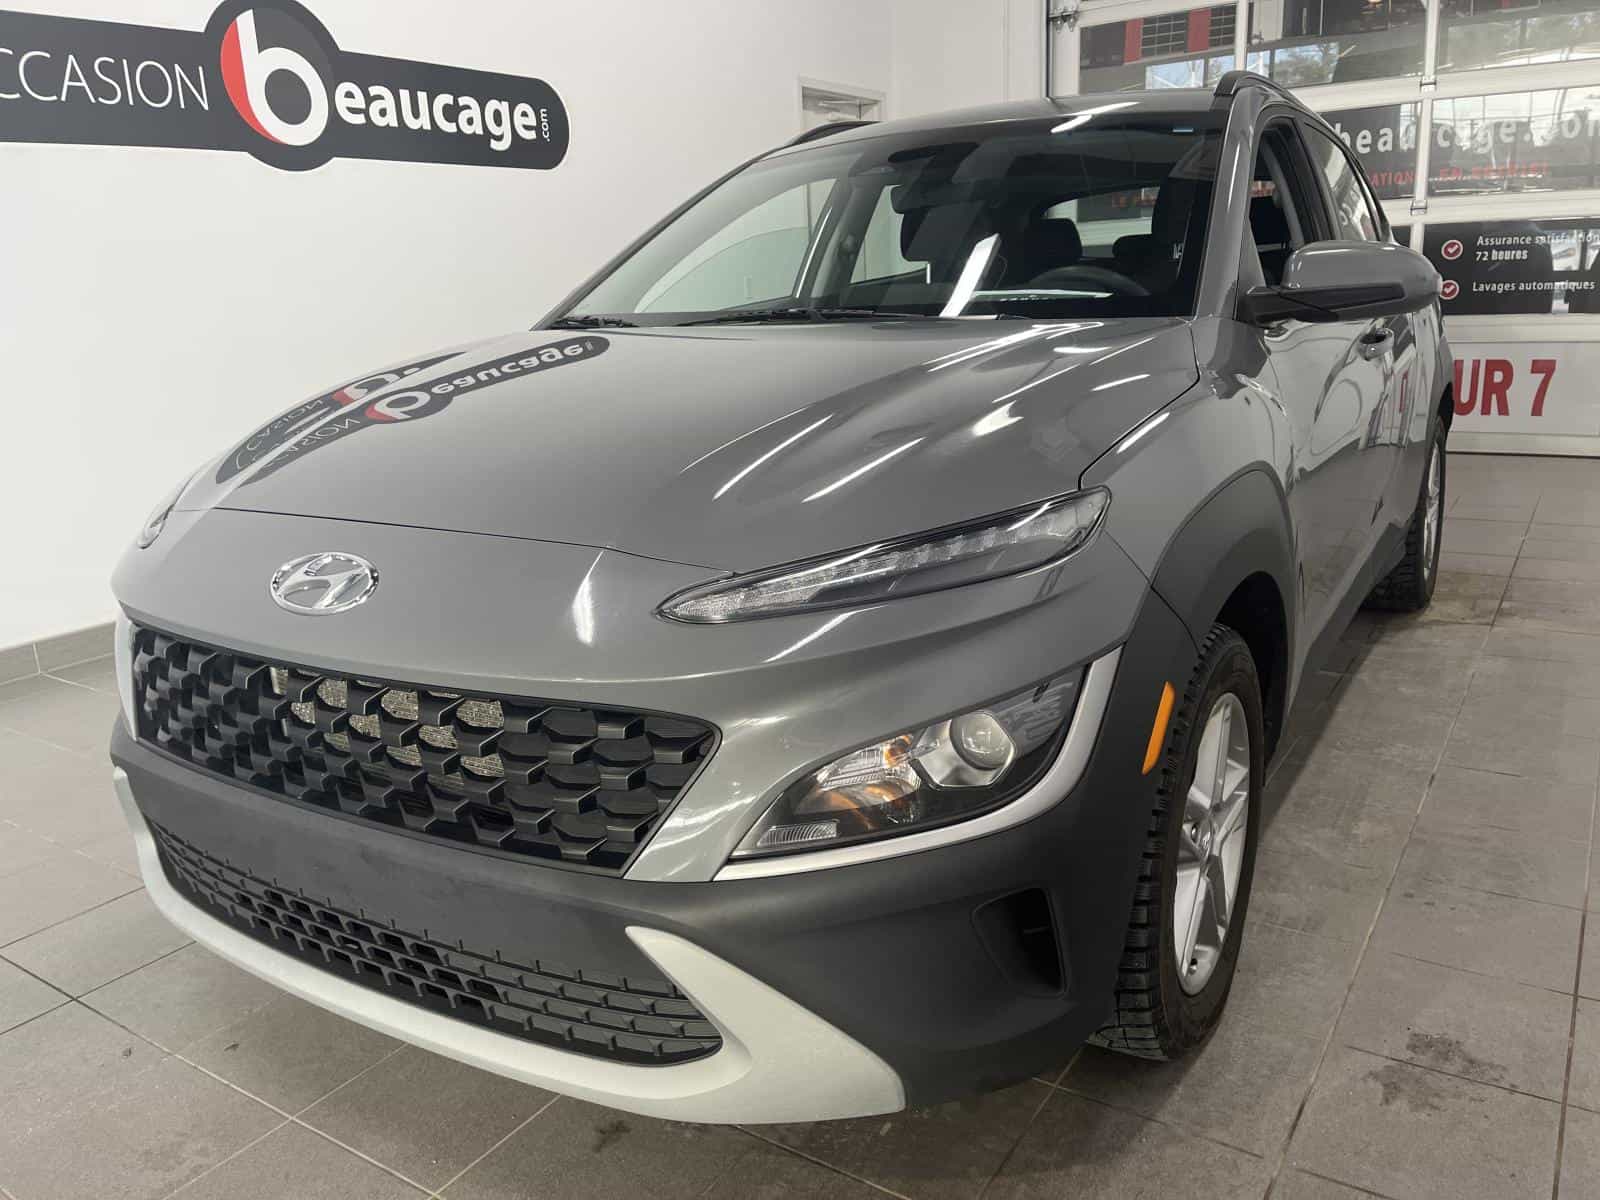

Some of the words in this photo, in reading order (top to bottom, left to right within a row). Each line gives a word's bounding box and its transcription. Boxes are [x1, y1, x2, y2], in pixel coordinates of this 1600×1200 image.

[1476, 235, 1531, 246] Assurance
[1475, 251, 1489, 261] 72
[1491, 249, 1528, 261] heures
[1472, 281, 1516, 294] Lavages
[1519, 280, 1596, 292] automatiques
[1530, 359, 1557, 416] 7
